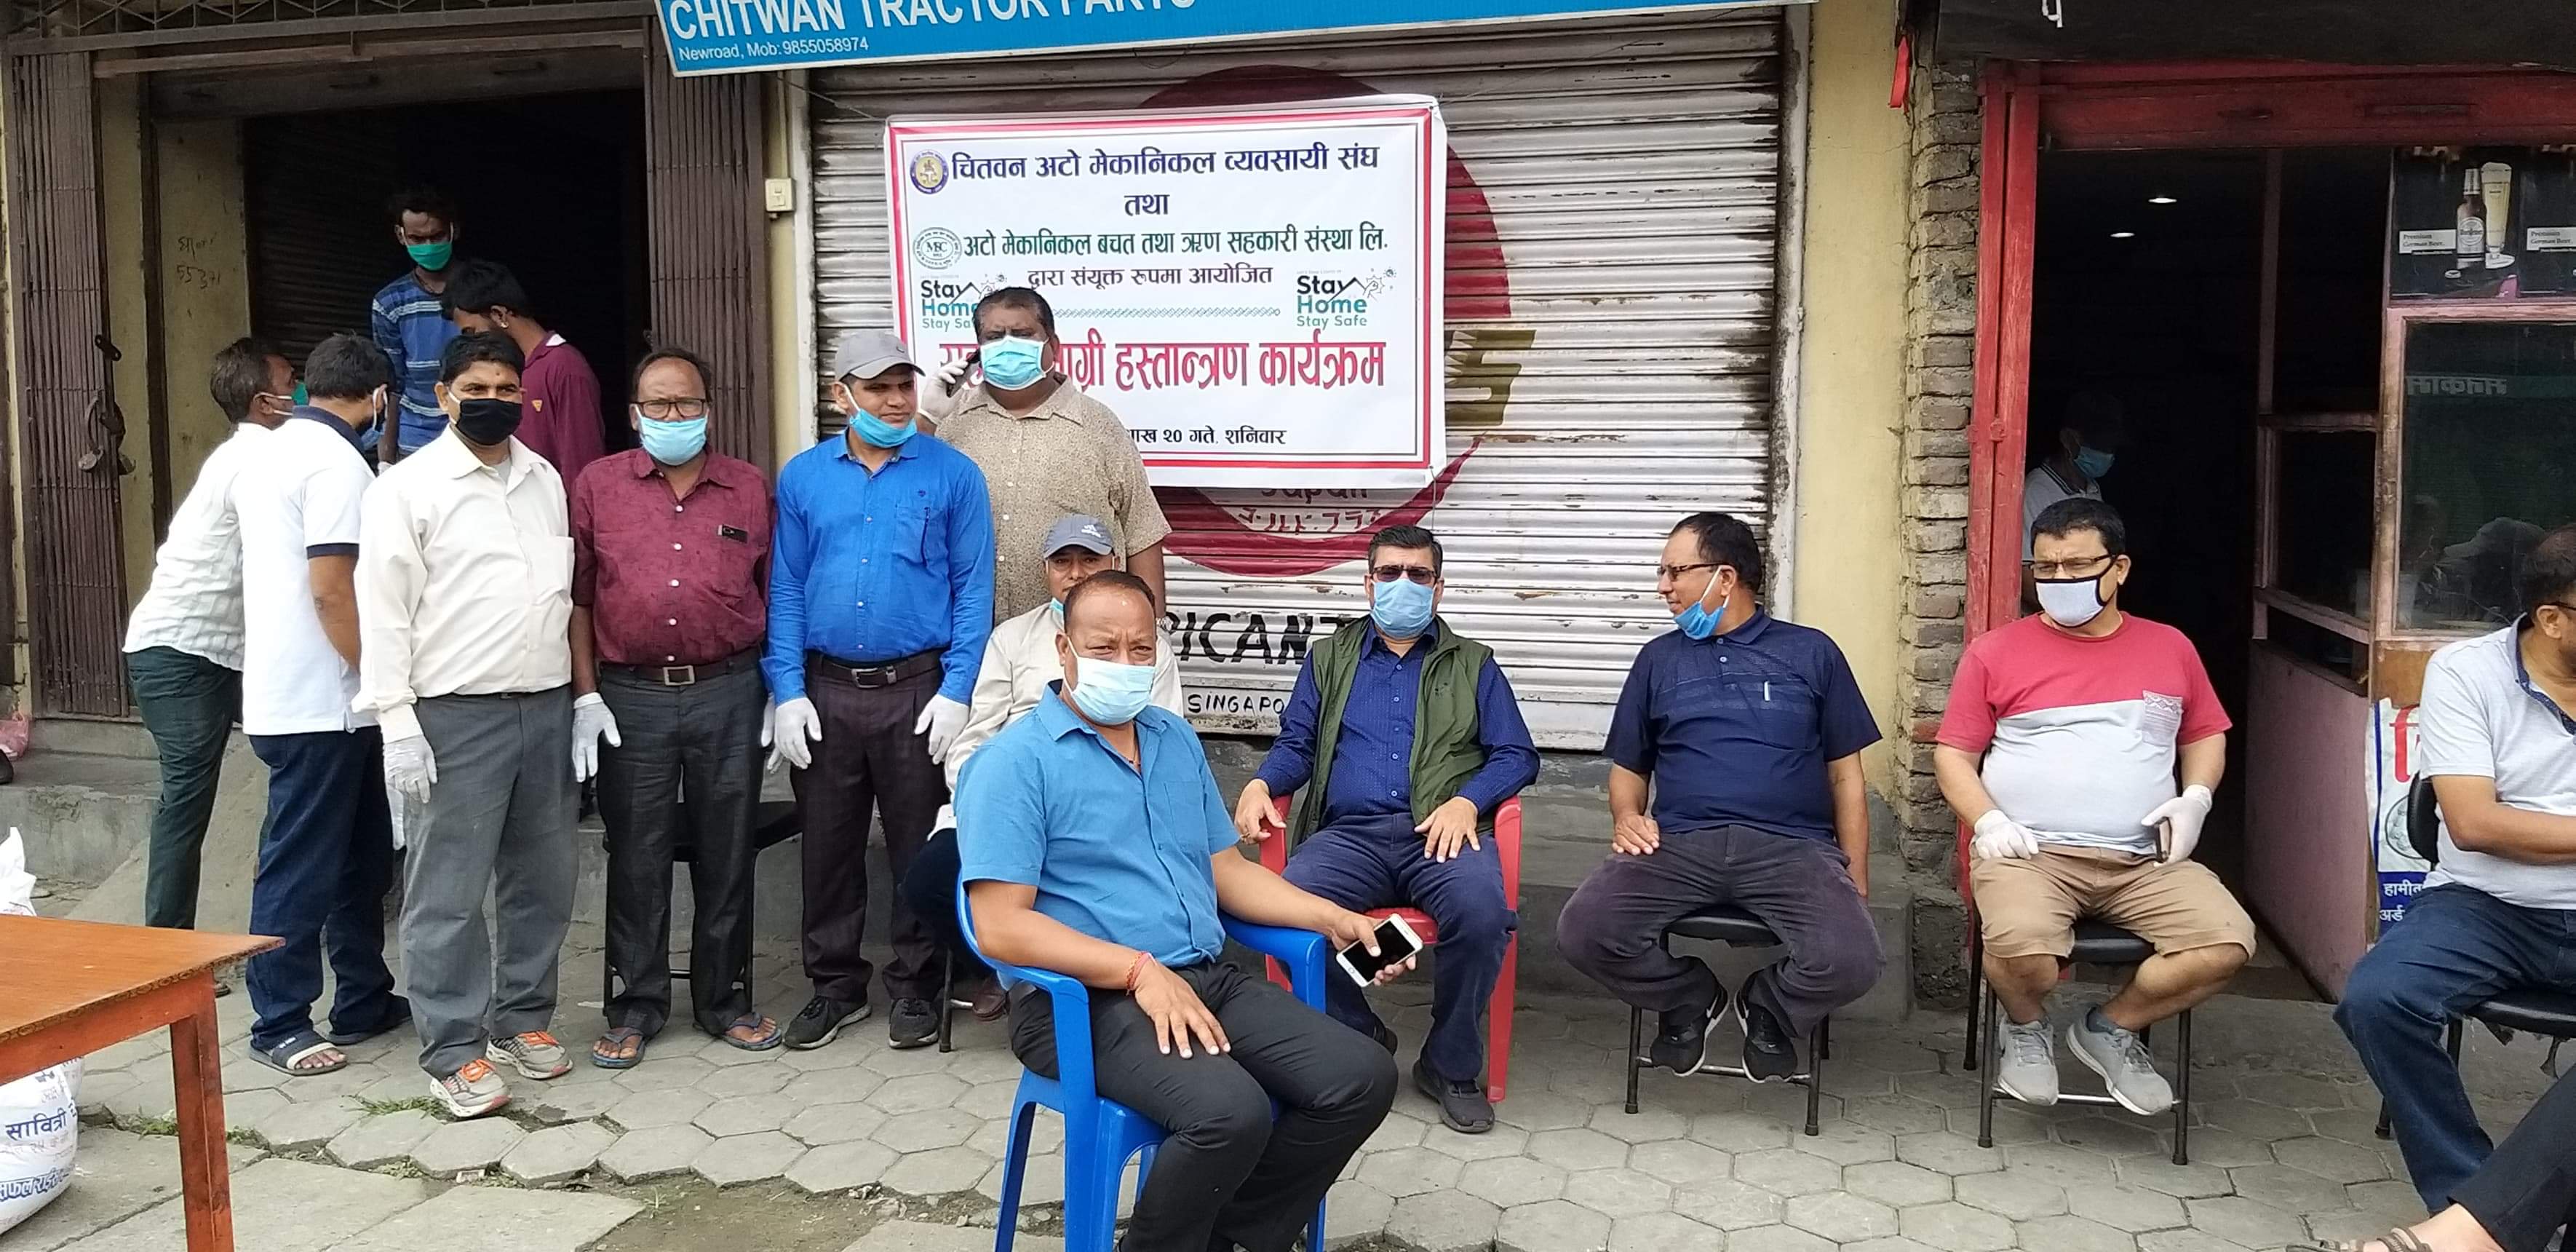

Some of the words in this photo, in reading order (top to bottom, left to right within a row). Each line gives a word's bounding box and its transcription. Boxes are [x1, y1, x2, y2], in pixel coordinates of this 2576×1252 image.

[669, 0, 845, 39] CHITWAN
[678, 44, 744, 61] Newroad,
[783, 37, 869, 55] 9855058974
[952, 151, 1027, 179] चितवन
[1035, 149, 1081, 177] अटो
[1089, 146, 1217, 175] मेकानिकल
[1225, 141, 1329, 172] व्यवसायी
[1337, 143, 1380, 170] संघ
[1124, 194, 1170, 216] तथा
[963, 229, 995, 255] अटो
[1002, 229, 1092, 255] मेकानिकल
[1097, 234, 1135, 255] बचत
[1141, 232, 1175, 253] तथा
[1180, 232, 1221, 253] ऋण
[1227, 223, 1298, 254] सहकारी
[1304, 225, 1353, 252] संस्था
[1027, 270, 1065, 290] द्वारा
[1188, 262, 1273, 284] आयोजित
[1297, 275, 1346, 297] Stay
[921, 280, 965, 300] Stay
[1297, 295, 1368, 314] Home
[922, 317, 950, 332] Stay
[955, 317, 974, 329] Sa
[1297, 316, 1329, 330] Stay
[1335, 314, 1368, 327] Safe
[1259, 328, 1386, 389] कार्यक्रम
[1164, 429, 1182, 443] २०
[1225, 425, 1287, 444] शनिवार
[1188, 694, 1285, 714] SINGAPO
[6, 1108, 66, 1141] सावित्री
